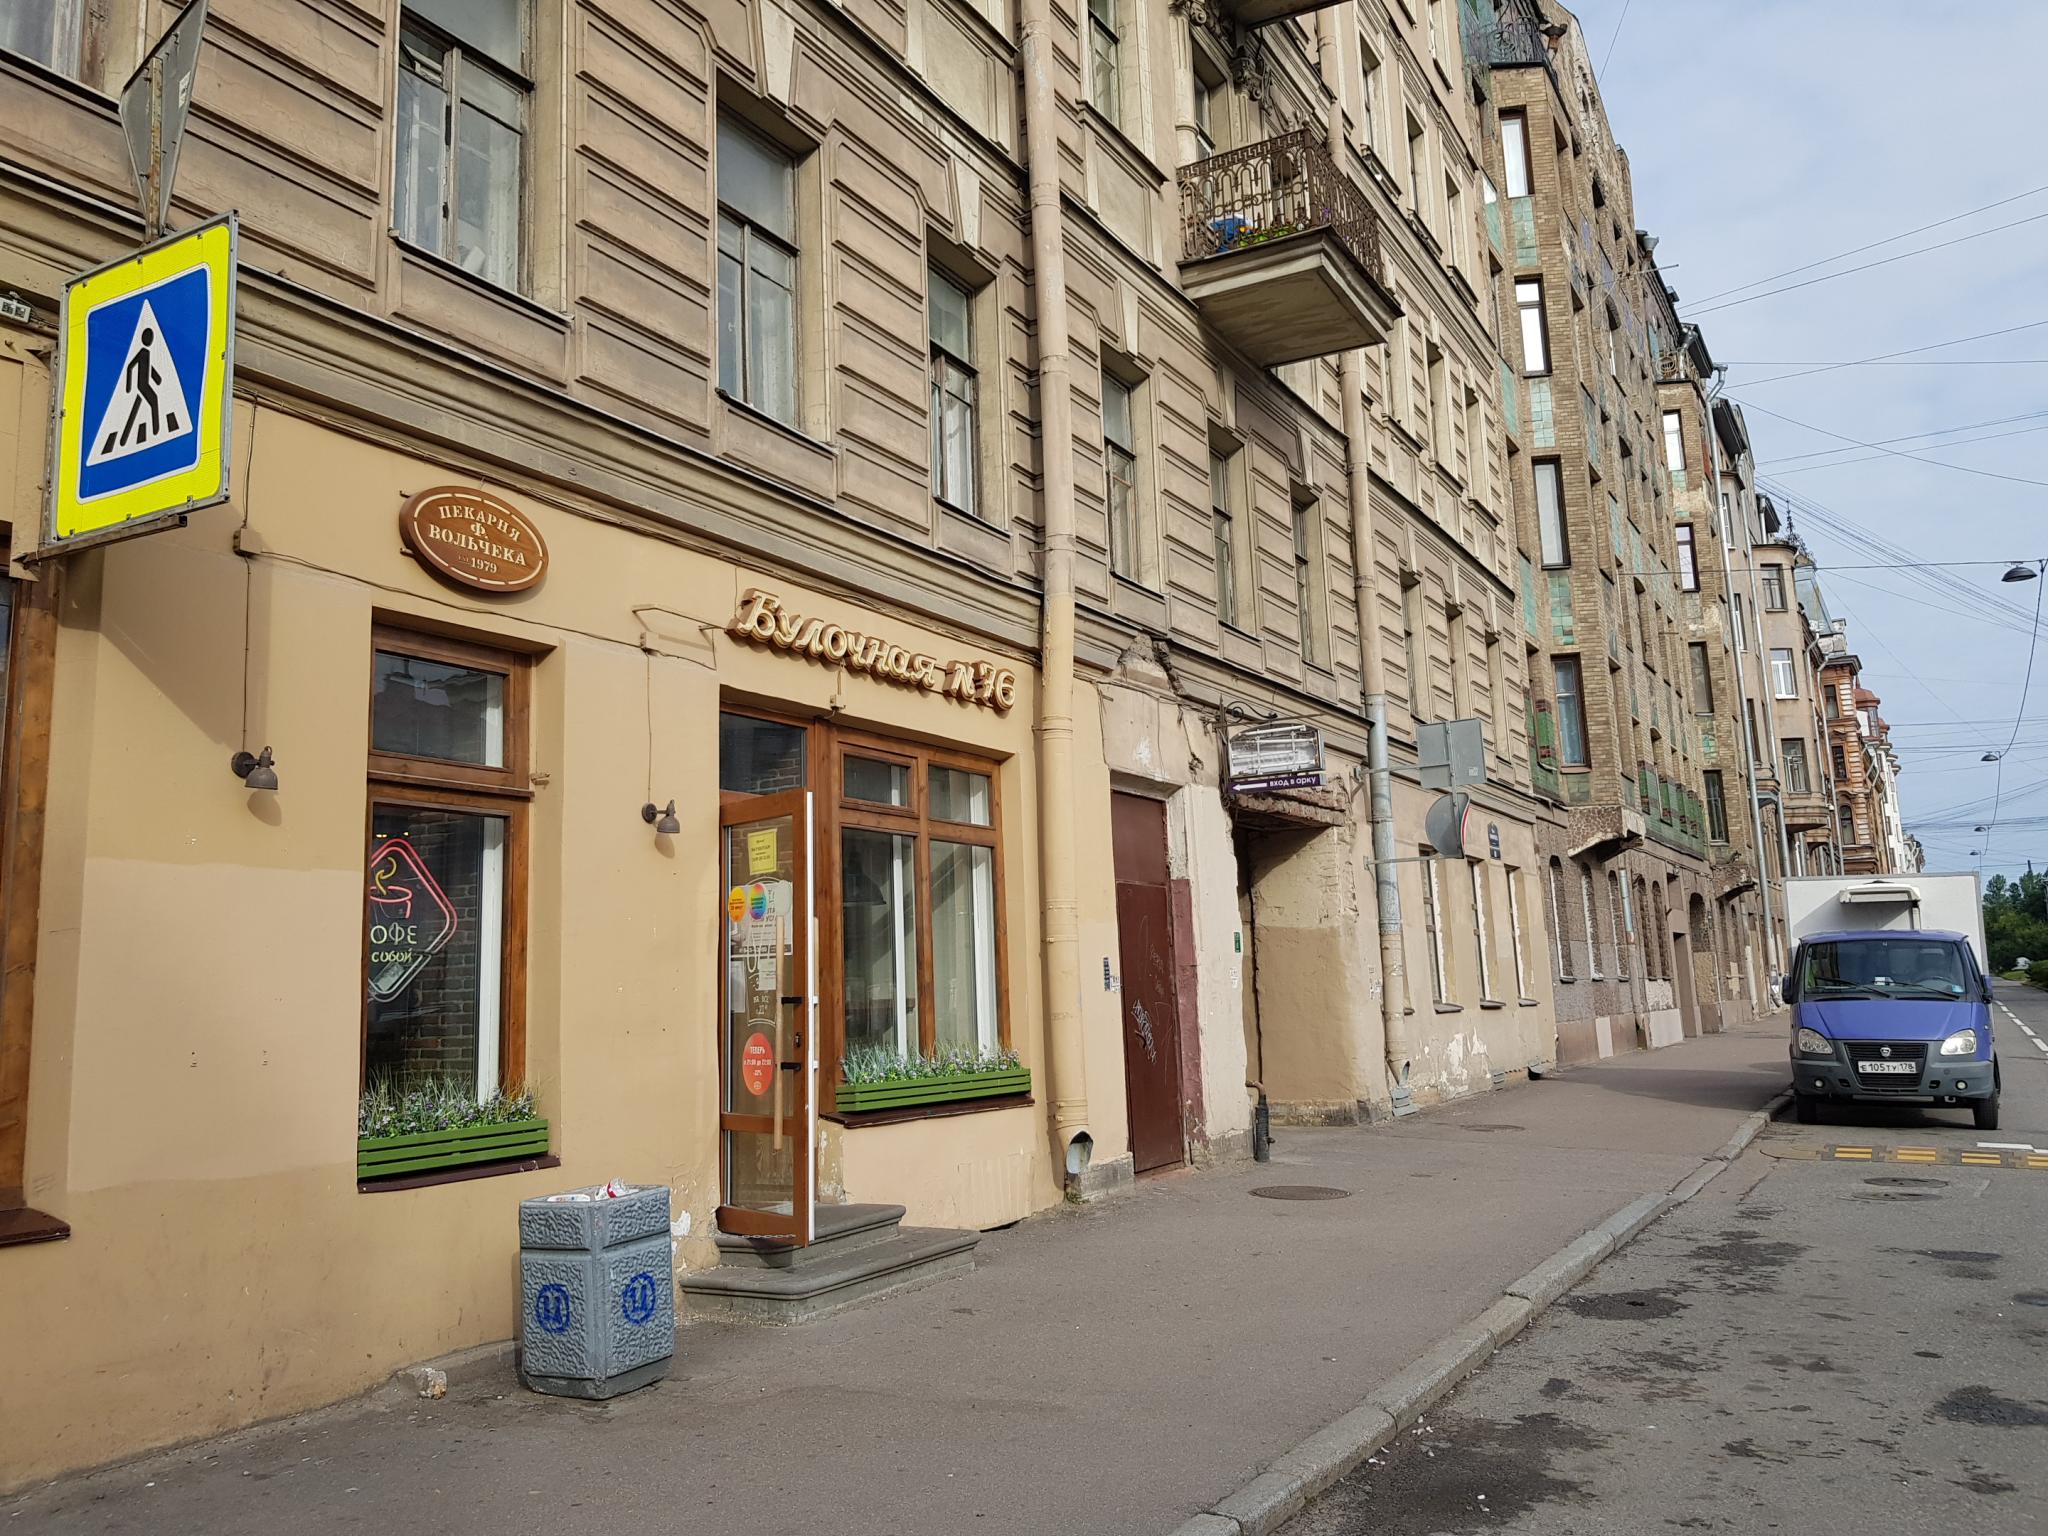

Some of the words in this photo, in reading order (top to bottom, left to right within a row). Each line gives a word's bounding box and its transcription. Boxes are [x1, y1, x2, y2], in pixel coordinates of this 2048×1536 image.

[438, 505, 521, 542] ПЕКАРНЯ
[470, 522, 488, 539] Ф.
[429, 524, 527, 566] ВОЛЬЧЕКА
[471, 557, 497, 573] 1979
[735, 588, 937, 690] Булочная
[1269, 779, 1290, 787] вход
[370, 922, 418, 945] ОФЕ
